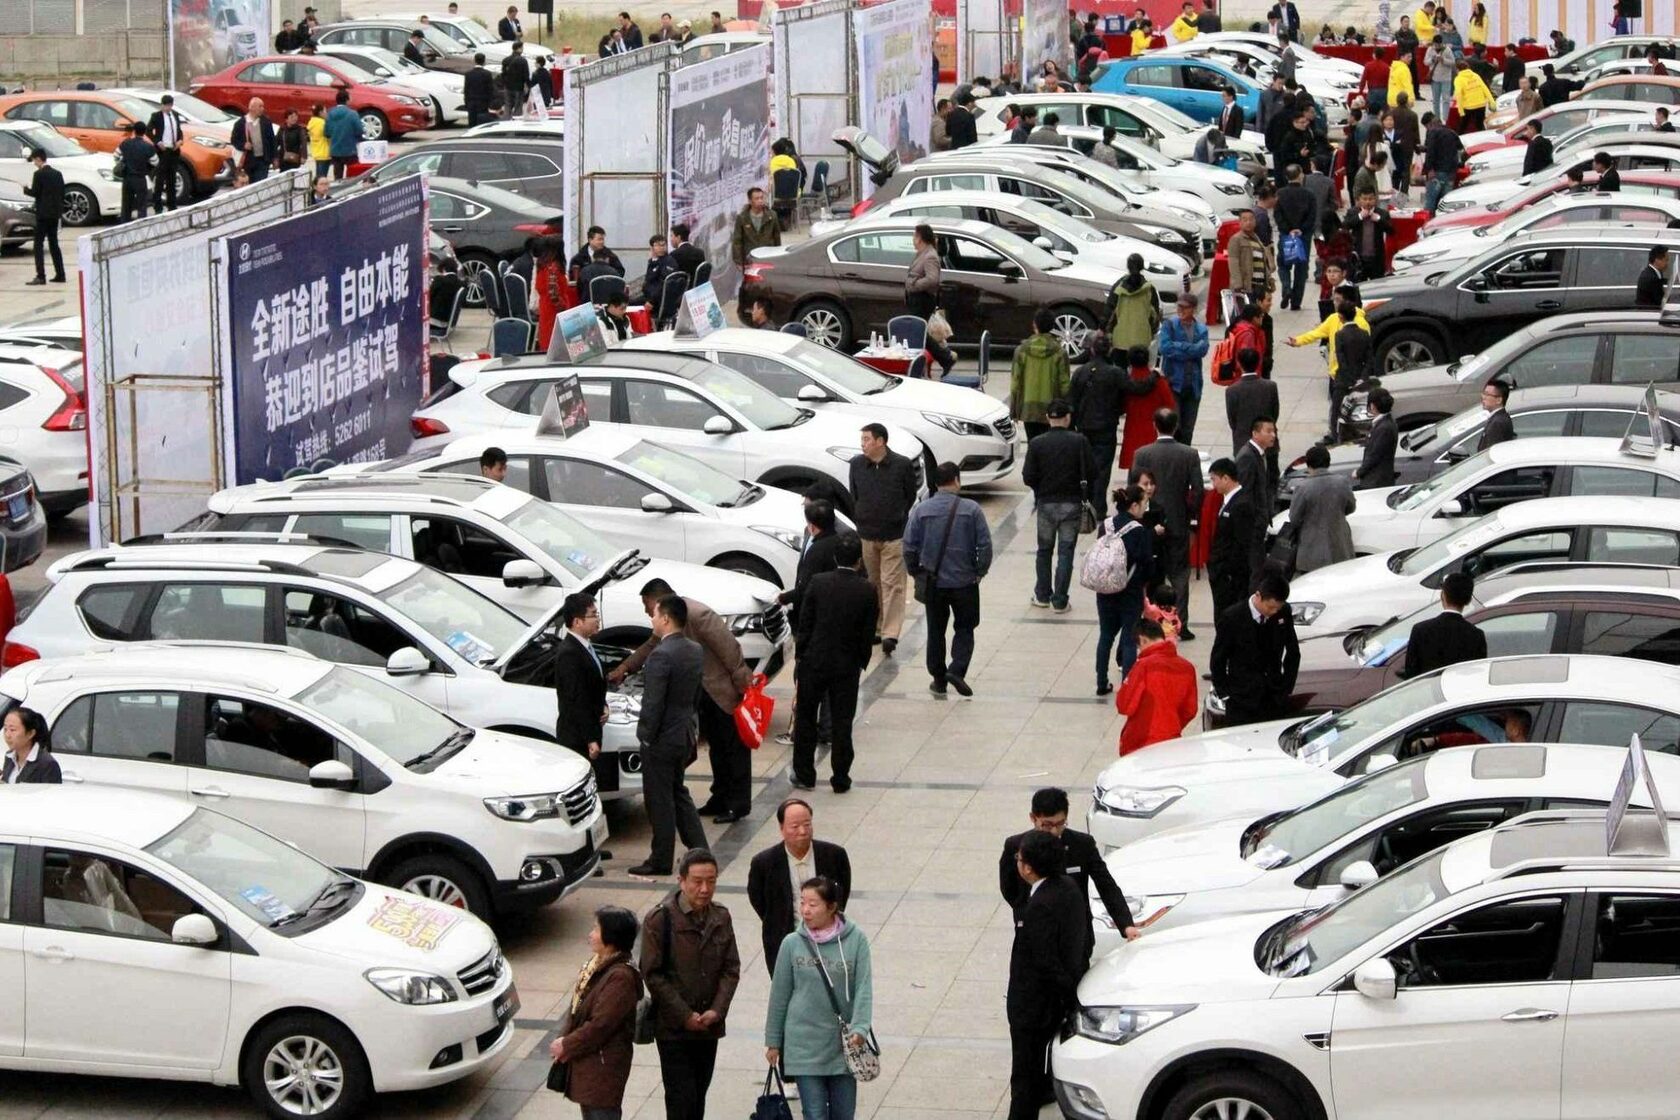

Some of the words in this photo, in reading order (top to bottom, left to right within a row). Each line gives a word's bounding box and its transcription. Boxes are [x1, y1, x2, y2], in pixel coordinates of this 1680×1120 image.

[251, 276, 329, 362] 全新途胜
[340, 243, 409, 325] 自由本能
[265, 323, 399, 433] 恭迎到店品鉴试驾
